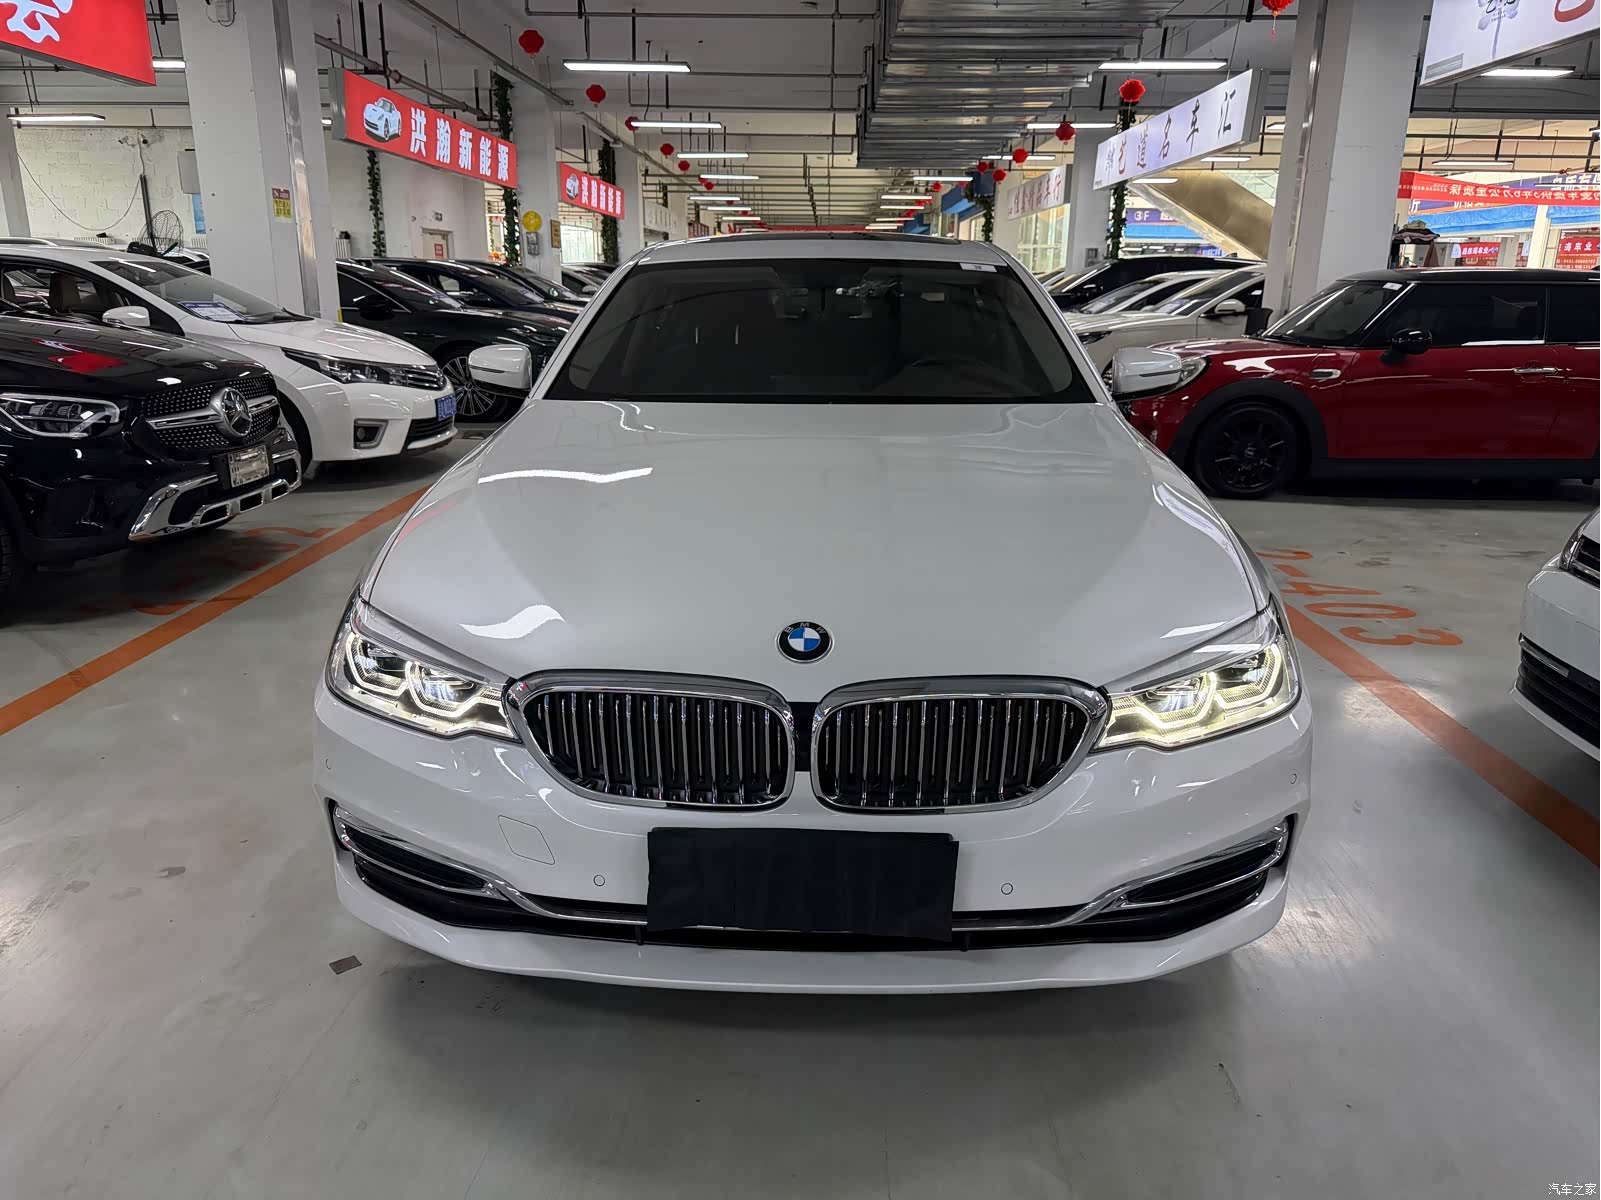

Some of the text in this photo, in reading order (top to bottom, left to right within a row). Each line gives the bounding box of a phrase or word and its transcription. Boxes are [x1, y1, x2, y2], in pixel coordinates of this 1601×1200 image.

[410, 106, 509, 182] 洪瀚新能源
[1558, 241, 1593, 252] 海车业
[784, 622, 826, 634] BMW
